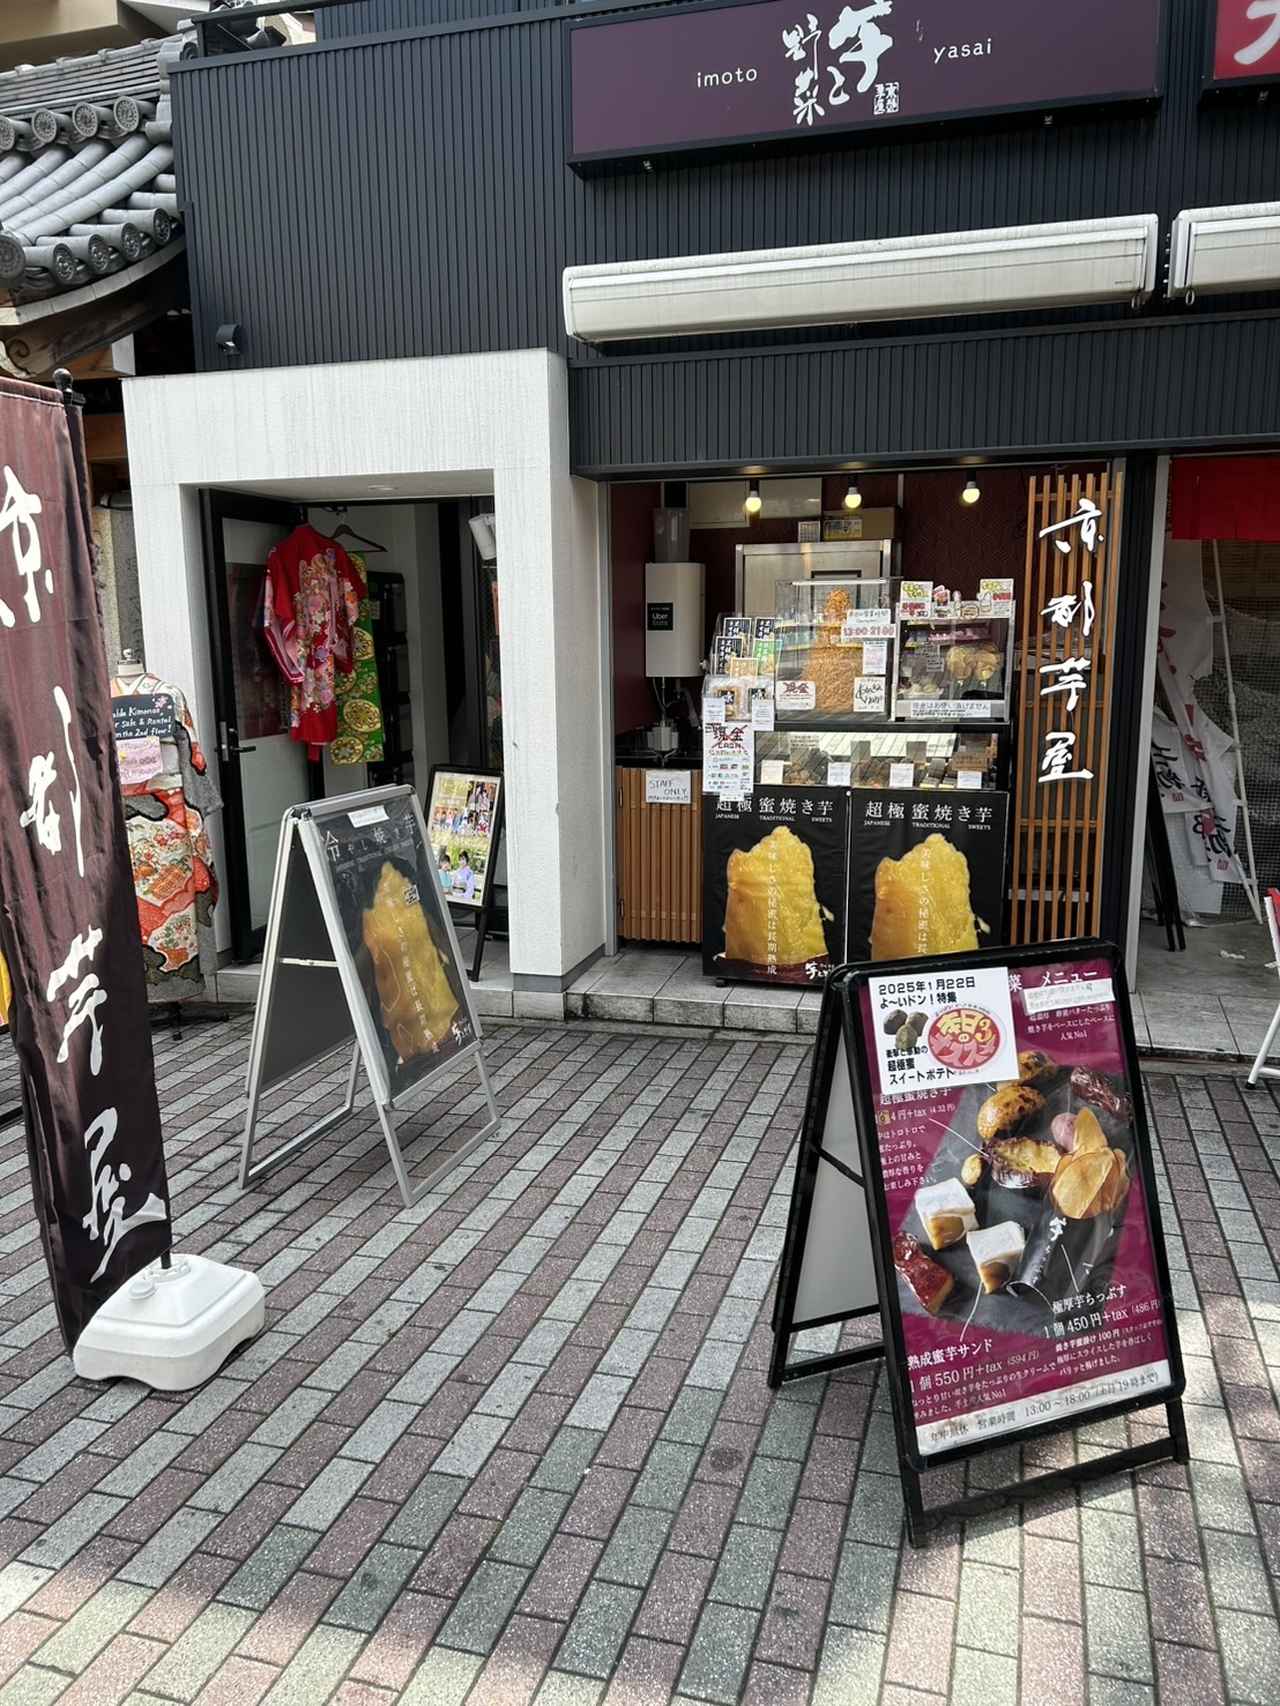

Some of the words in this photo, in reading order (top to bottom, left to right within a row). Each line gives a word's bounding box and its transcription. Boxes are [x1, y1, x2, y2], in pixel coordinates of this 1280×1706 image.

[933, 38, 992, 64] yasai
[696, 67, 758, 88] imoto
[1038, 497, 1103, 784] 京都芋屋
[865, 800, 993, 823] 超極蜜焼き芋
[878, 975, 976, 996] 2025年1月22日
[1041, 970, 1098, 988] メニュー
[888, 1057, 916, 1072] 超極蜜
[889, 1067, 954, 1085] スイートポテト
[907, 1339, 993, 1371] 熟成蜜芋サンド
